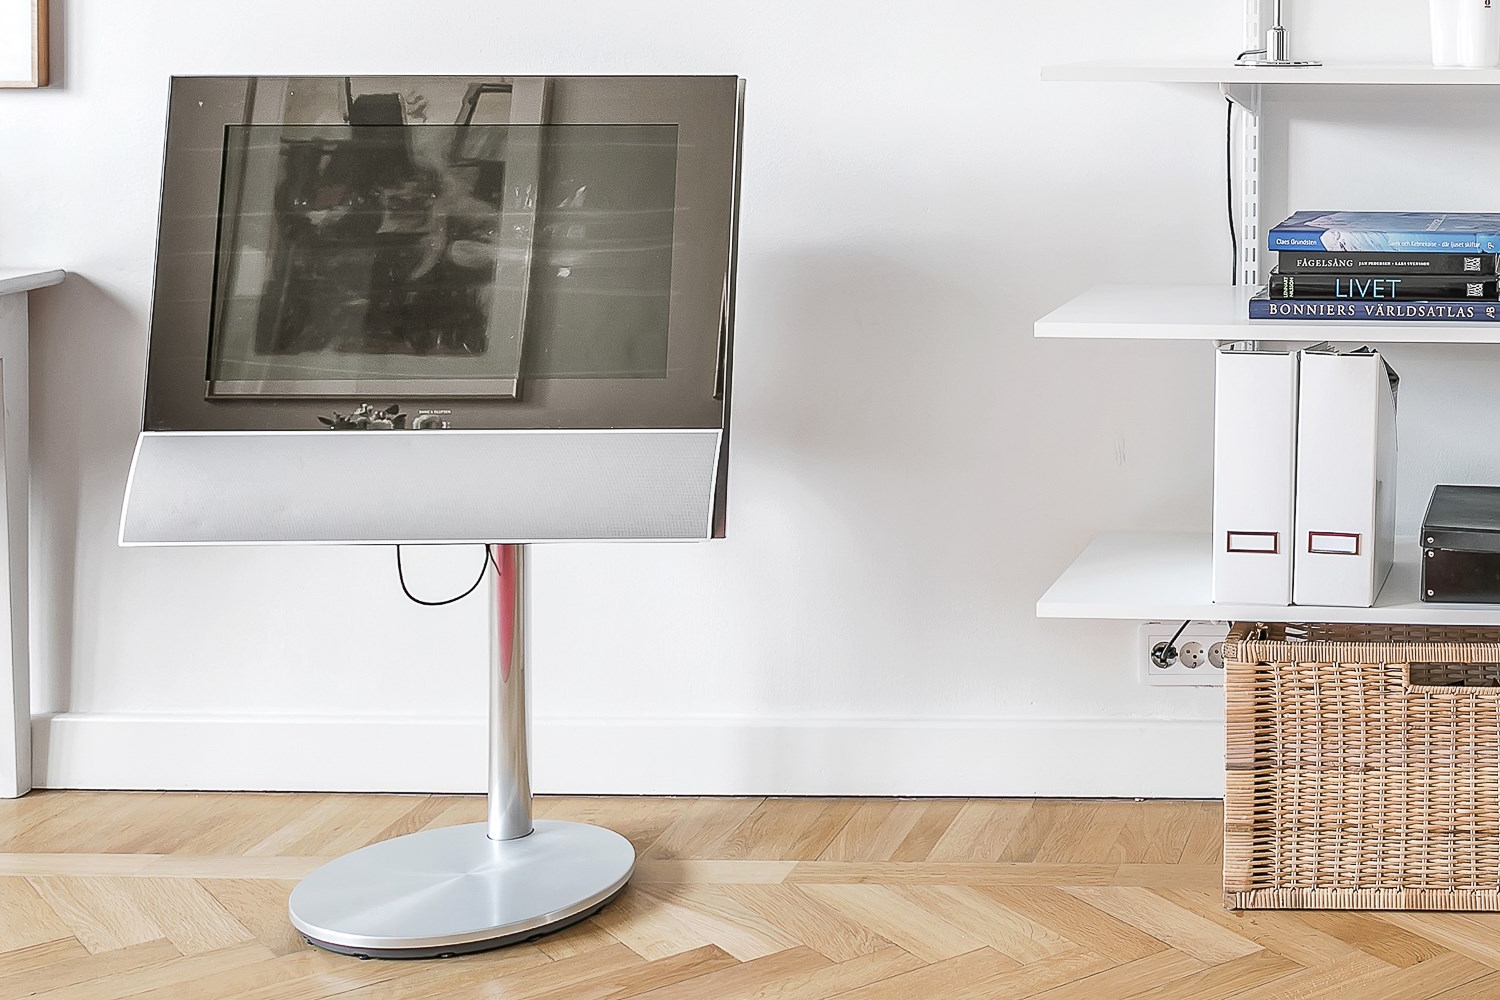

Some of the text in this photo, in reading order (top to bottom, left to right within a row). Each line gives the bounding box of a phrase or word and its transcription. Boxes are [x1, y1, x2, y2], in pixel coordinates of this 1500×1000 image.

[1296, 258, 1353, 267] FÅGELSÅNG
[1336, 279, 1402, 298] LIVET
[1269, 303, 1474, 318] BONNIERS VÄRLDSATLAS
